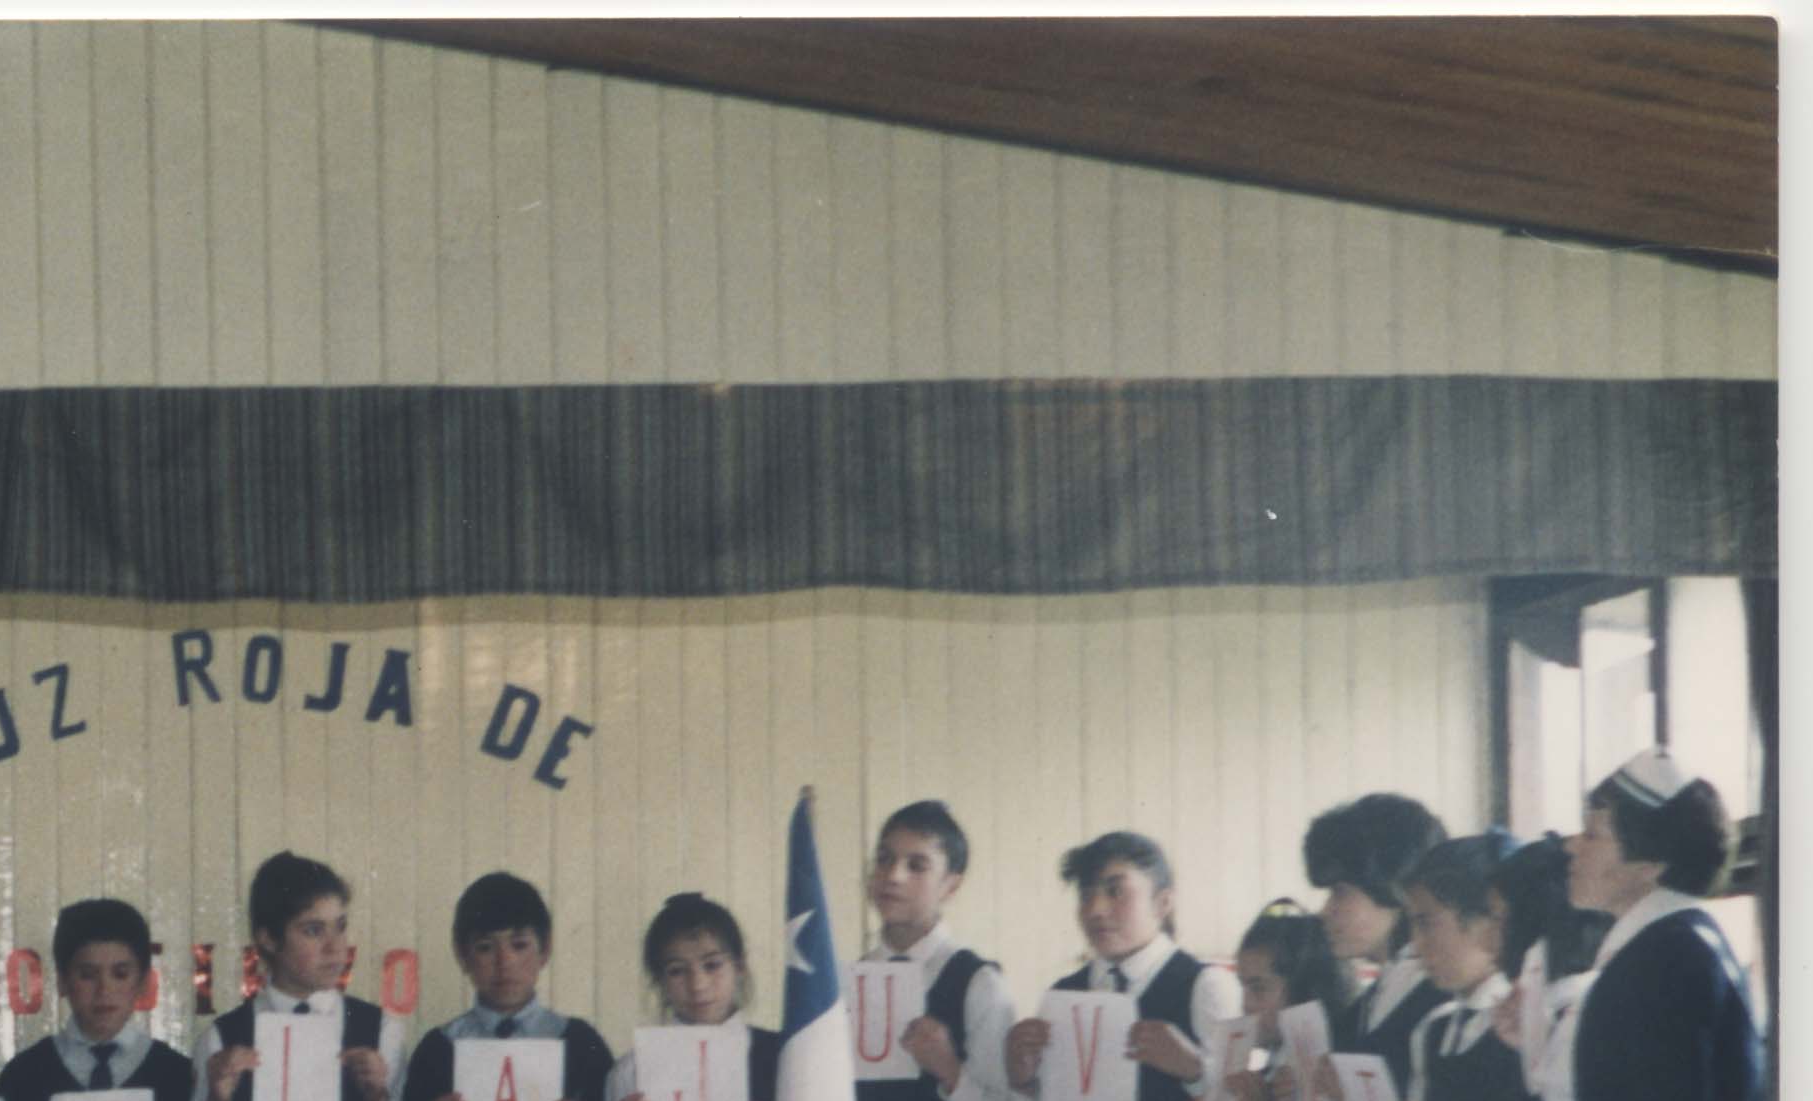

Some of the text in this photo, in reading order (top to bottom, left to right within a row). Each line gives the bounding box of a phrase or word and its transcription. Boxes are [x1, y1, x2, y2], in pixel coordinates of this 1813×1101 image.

[172, 628, 415, 728] ROJA
[480, 683, 596, 791] DE
[855, 973, 893, 1063] U
[1073, 1004, 1104, 1097] V
